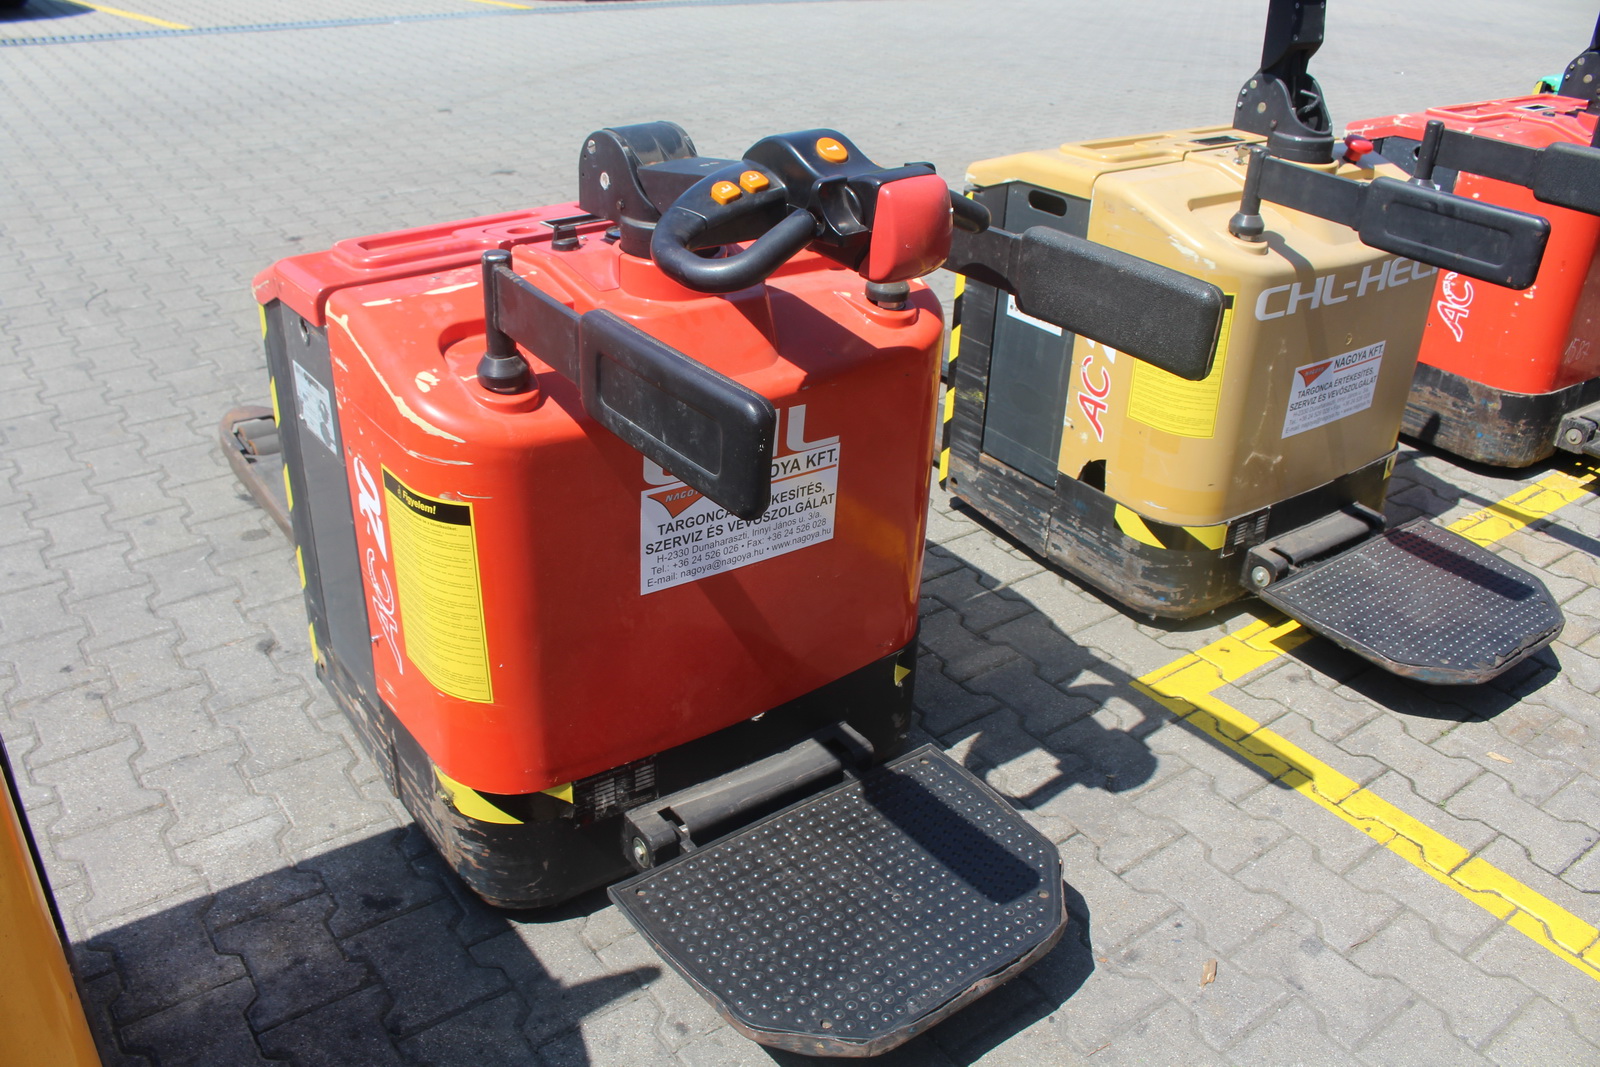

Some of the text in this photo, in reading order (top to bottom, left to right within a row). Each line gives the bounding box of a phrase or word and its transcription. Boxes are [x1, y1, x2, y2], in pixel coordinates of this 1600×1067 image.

[1255, 256, 1439, 321] CHL-HEL
[1334, 350, 1367, 369] NAGOYA
[1078, 355, 1112, 443] AC
[1289, 397, 1317, 411] SZERVIZ
[1318, 393, 1327, 403] ÉS
[1298, 382, 1334, 399] TARGONCA
[806, 448, 838, 470] KFT.
[402, 489, 437, 514] Figyelem!
[665, 489, 699, 502] NAGO
[771, 481, 826, 506] KESÍTÉS,
[645, 529, 703, 555] SZERVIZ
[706, 524, 724, 539] ÉS
[651, 518, 827, 576] Tel.: +36 24 526 026 Fax: +36 24 526 028
[656, 511, 822, 563] H-2330 Dunaharaszti, Irinyi János u. 3/a.
[353, 456, 404, 675] AC 20
[647, 528, 832, 588] E-mail: nagoya@nagoya.hu www.nagoya.hu
